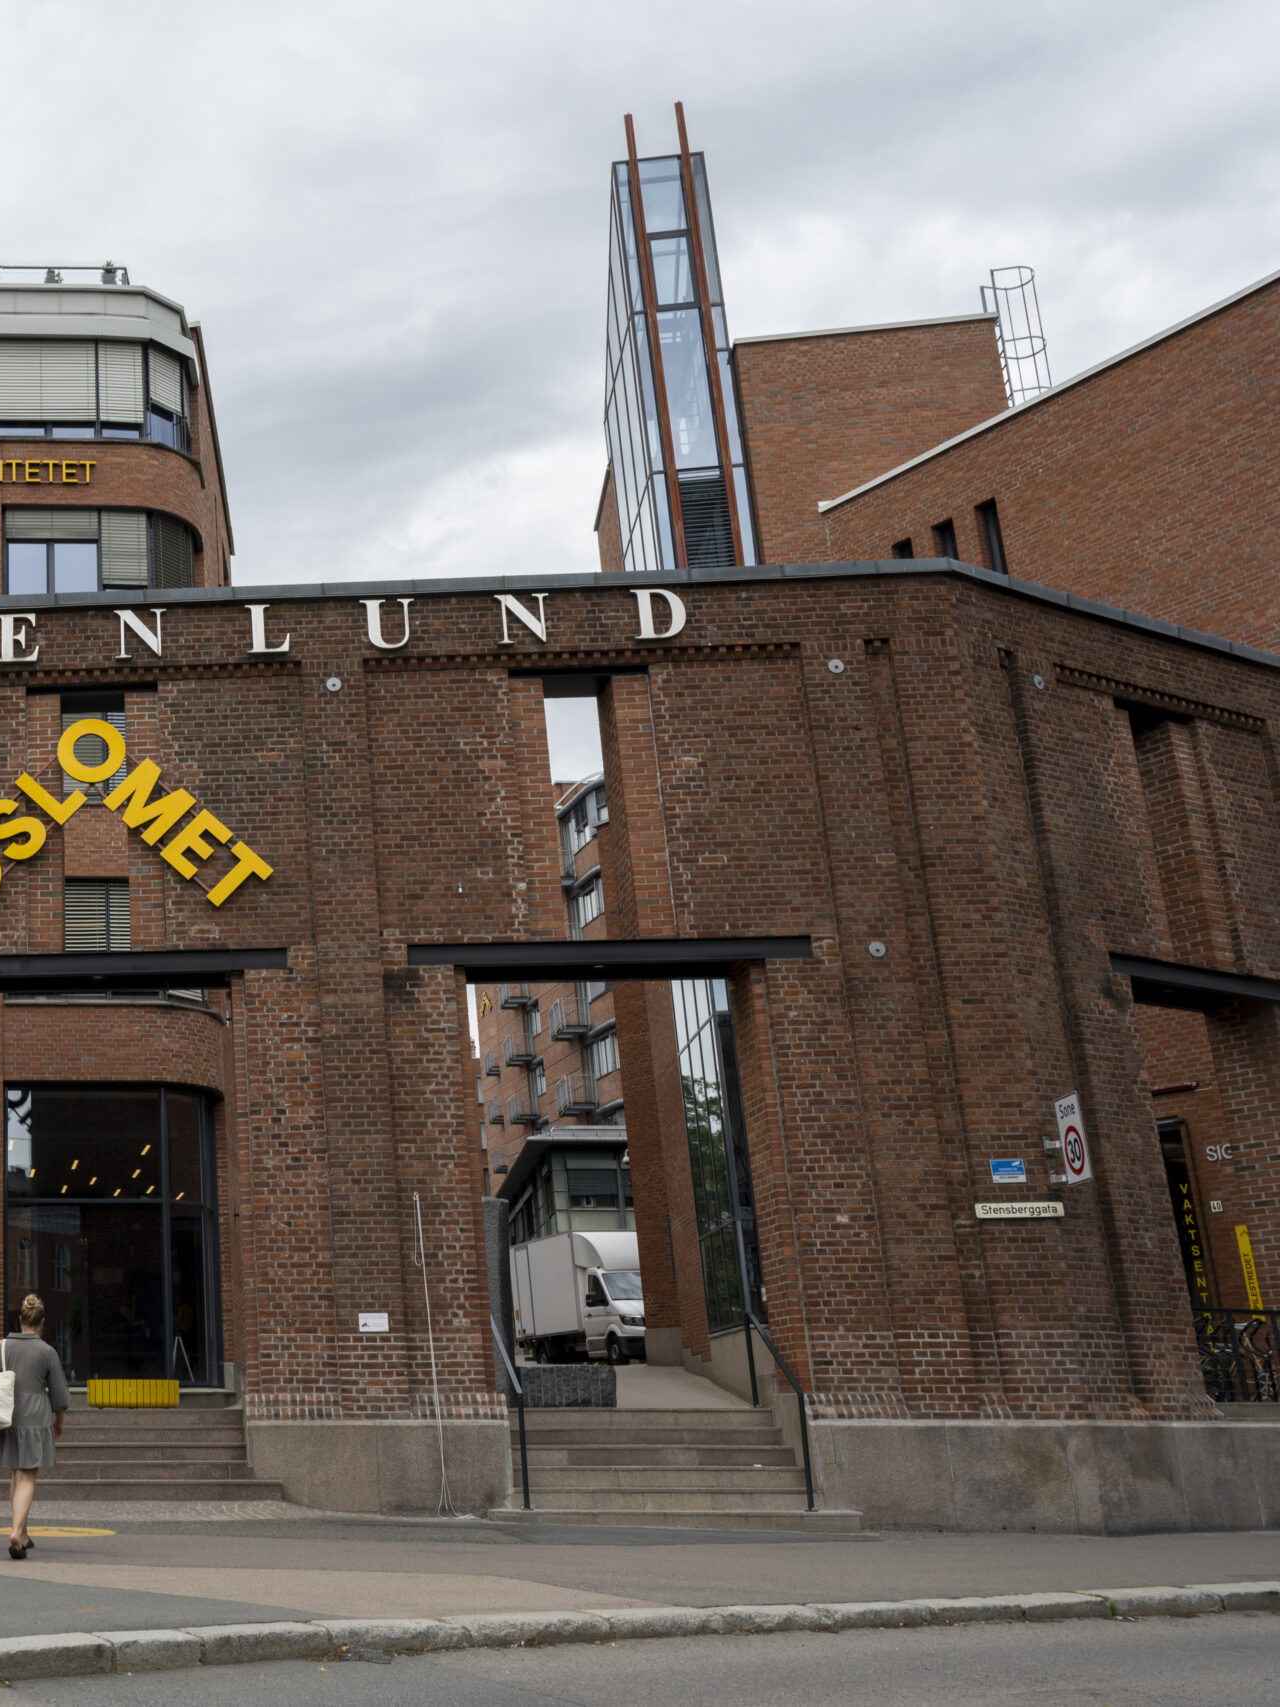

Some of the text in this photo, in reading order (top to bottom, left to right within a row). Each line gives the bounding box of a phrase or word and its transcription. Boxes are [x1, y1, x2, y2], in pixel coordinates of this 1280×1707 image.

[1058, 1103, 1076, 1119] Sone
[1067, 1138, 1082, 1164] 30
[981, 1204, 1058, 1217] Stensberggata
[1243, 1252, 1260, 1310] PILESTREDET
